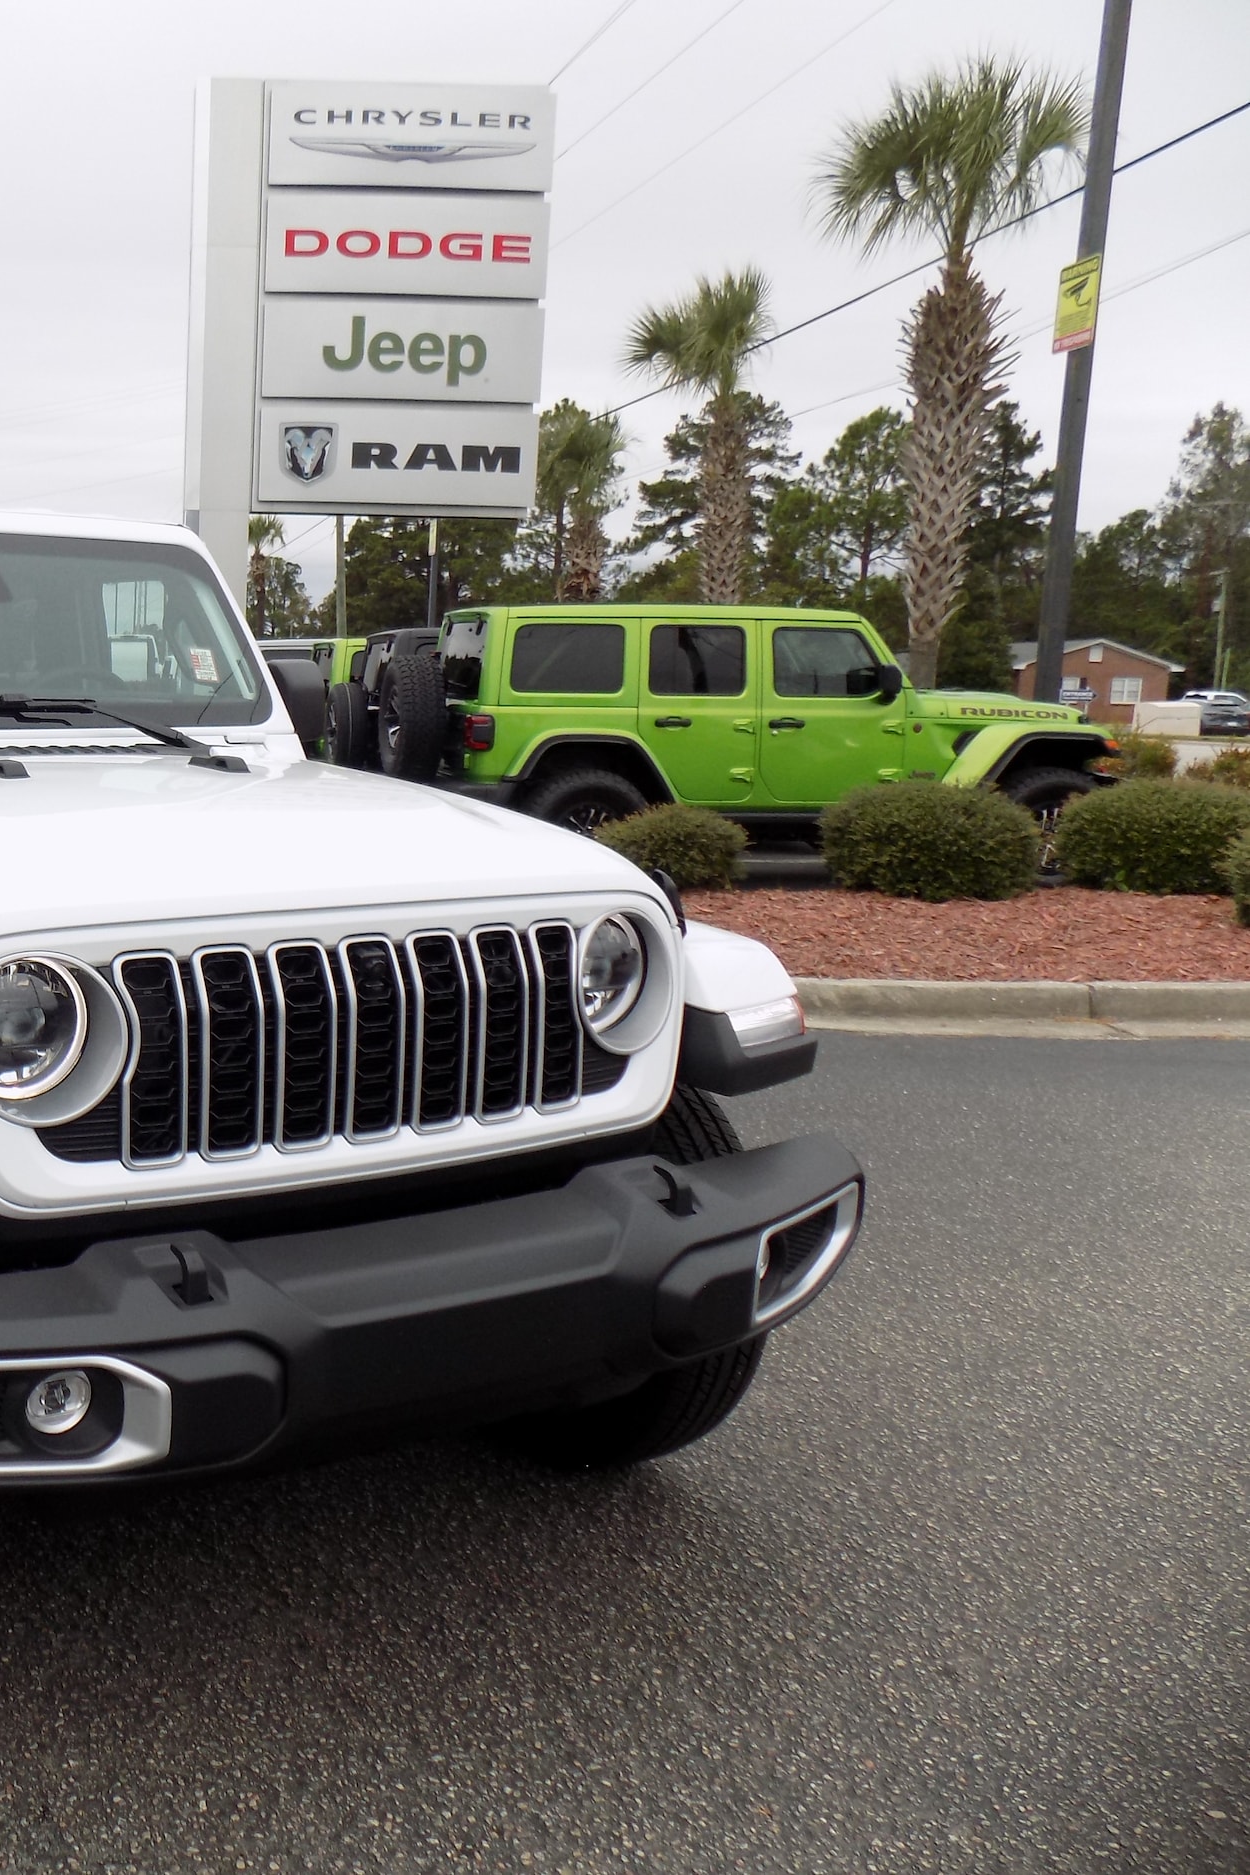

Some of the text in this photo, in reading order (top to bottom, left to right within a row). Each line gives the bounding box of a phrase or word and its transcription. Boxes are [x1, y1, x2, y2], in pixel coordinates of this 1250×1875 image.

[293, 108, 532, 131] CHRYSLER
[284, 229, 532, 264] DODGE
[322, 315, 487, 387] Jeep
[351, 441, 521, 474] RAM
[960, 706, 1069, 720] RUBICON
